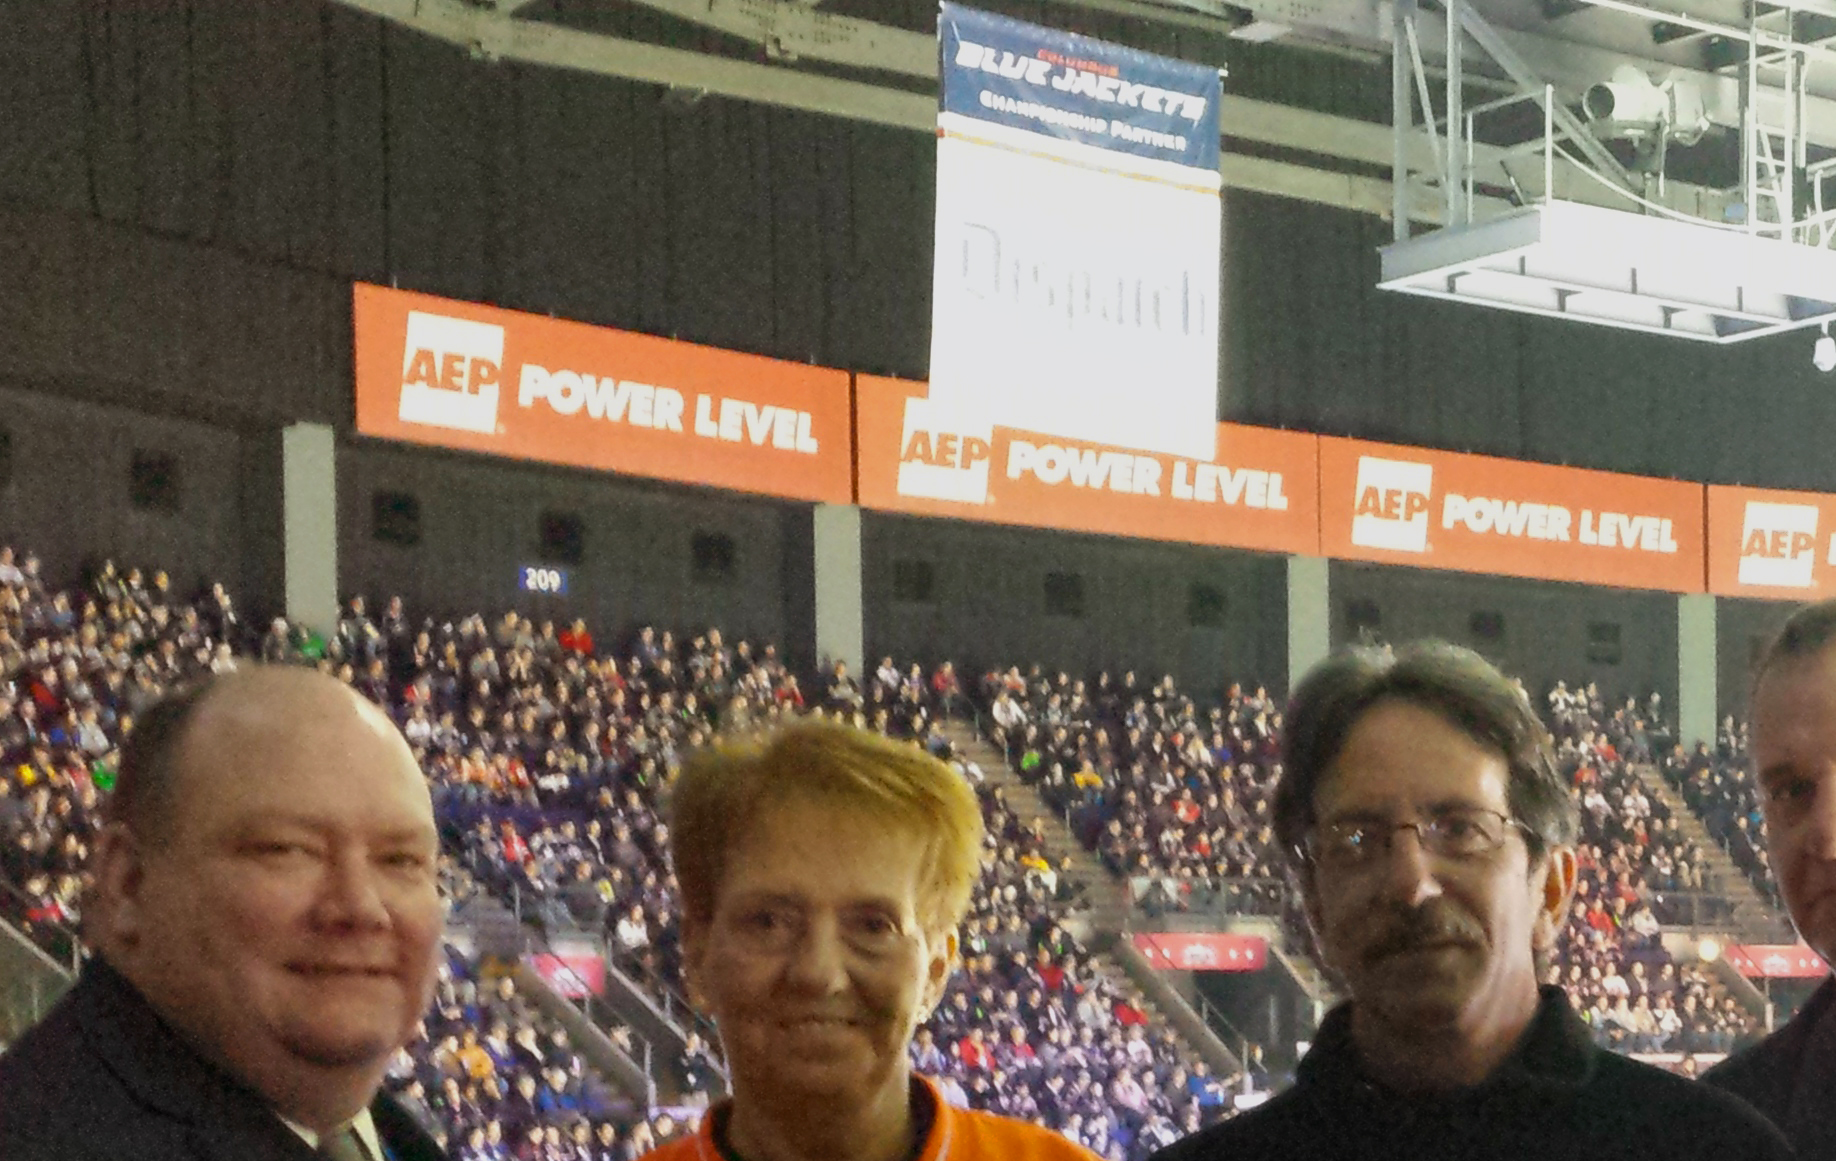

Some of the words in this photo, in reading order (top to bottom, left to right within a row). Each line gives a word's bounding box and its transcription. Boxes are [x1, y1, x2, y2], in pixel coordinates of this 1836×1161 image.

[955, 40, 1051, 86] BLUE
[1051, 67, 1207, 121] JACKETS
[405, 348, 500, 396] AEP
[517, 364, 685, 433] POWER
[694, 394, 819, 454] LEVEL
[902, 431, 990, 471] AEP
[1006, 441, 1163, 495] POWER
[1171, 460, 1288, 511] LEVEL
[1355, 486, 1430, 522] AEP
[1442, 494, 1571, 542] POWER
[1579, 509, 1678, 553] LEVEL
[1742, 527, 1815, 560] AEP
[525, 566, 562, 593] 209
